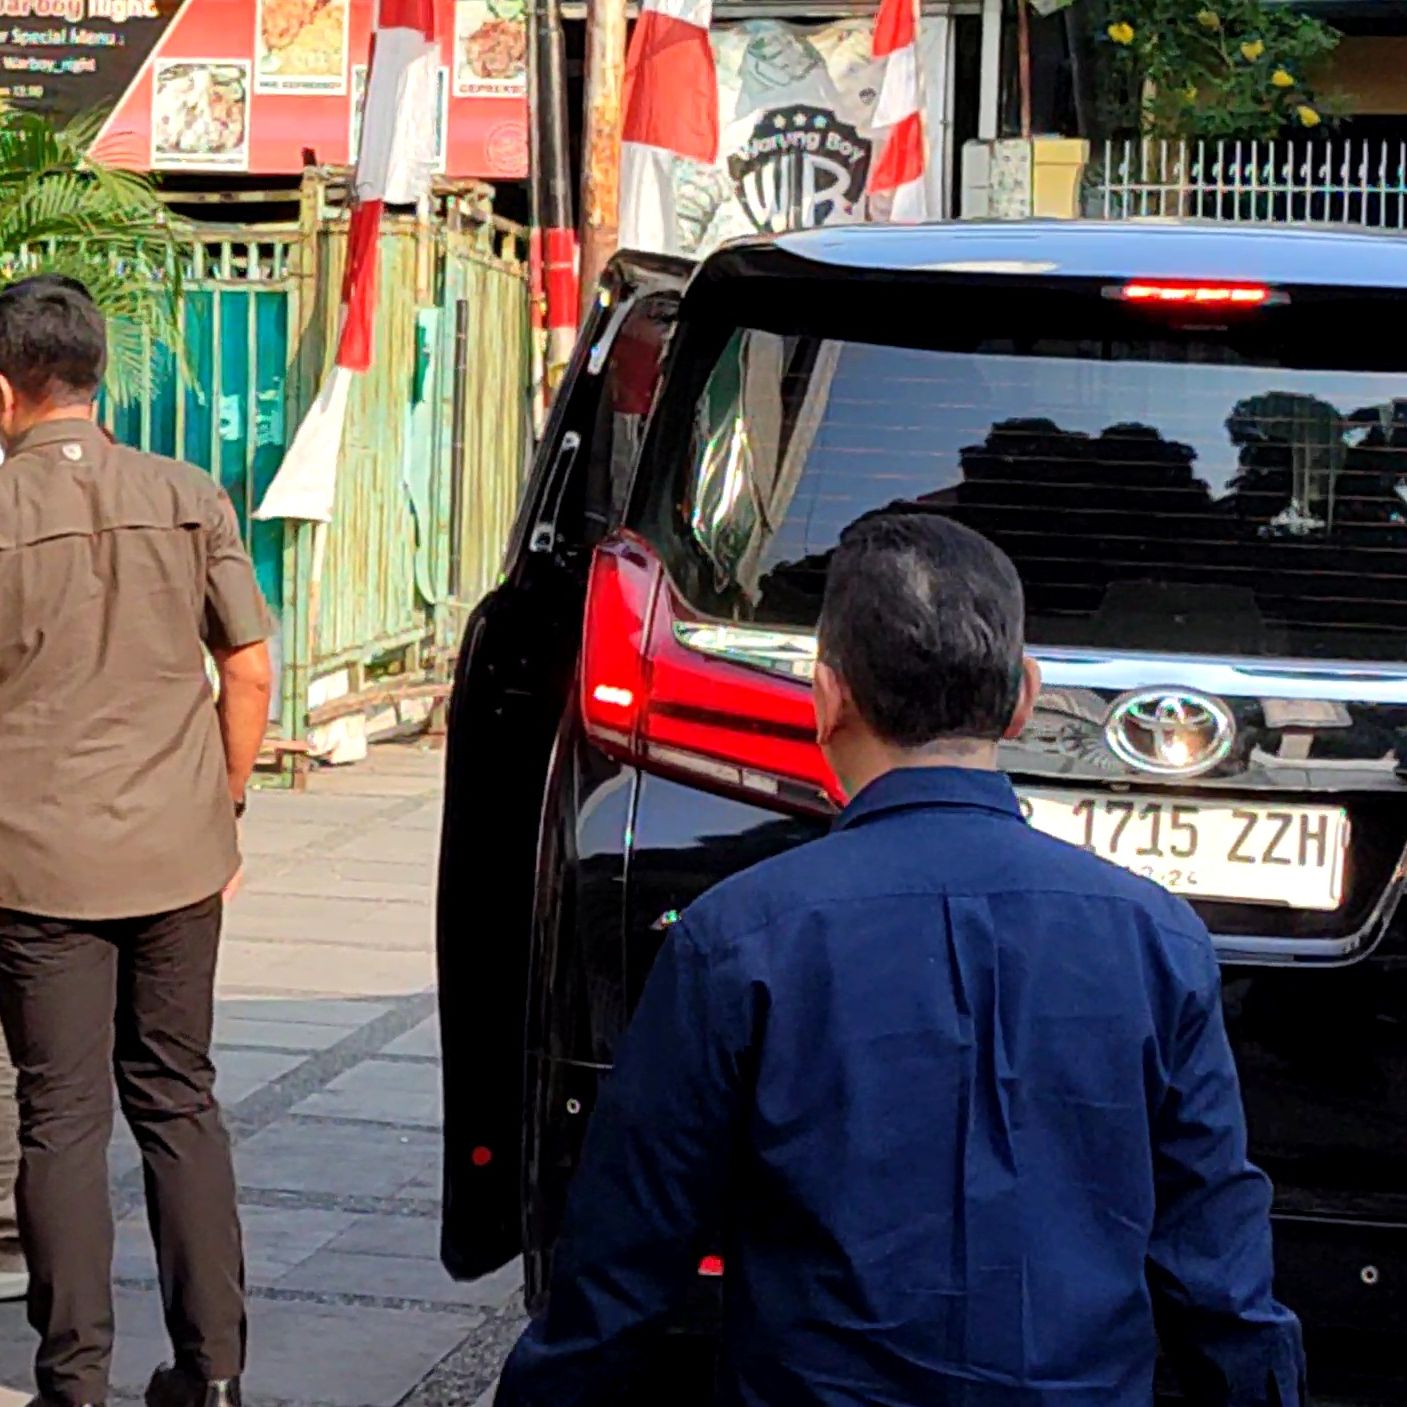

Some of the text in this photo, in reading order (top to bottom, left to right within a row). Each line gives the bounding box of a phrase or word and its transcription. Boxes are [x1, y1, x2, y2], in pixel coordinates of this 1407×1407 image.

[12, 26, 67, 47] Special
[69, 28, 116, 46] Menu
[826, 132, 866, 163] Boy
[1072, 800, 1199, 858] 1715
[1227, 810, 1329, 868] ZZH
